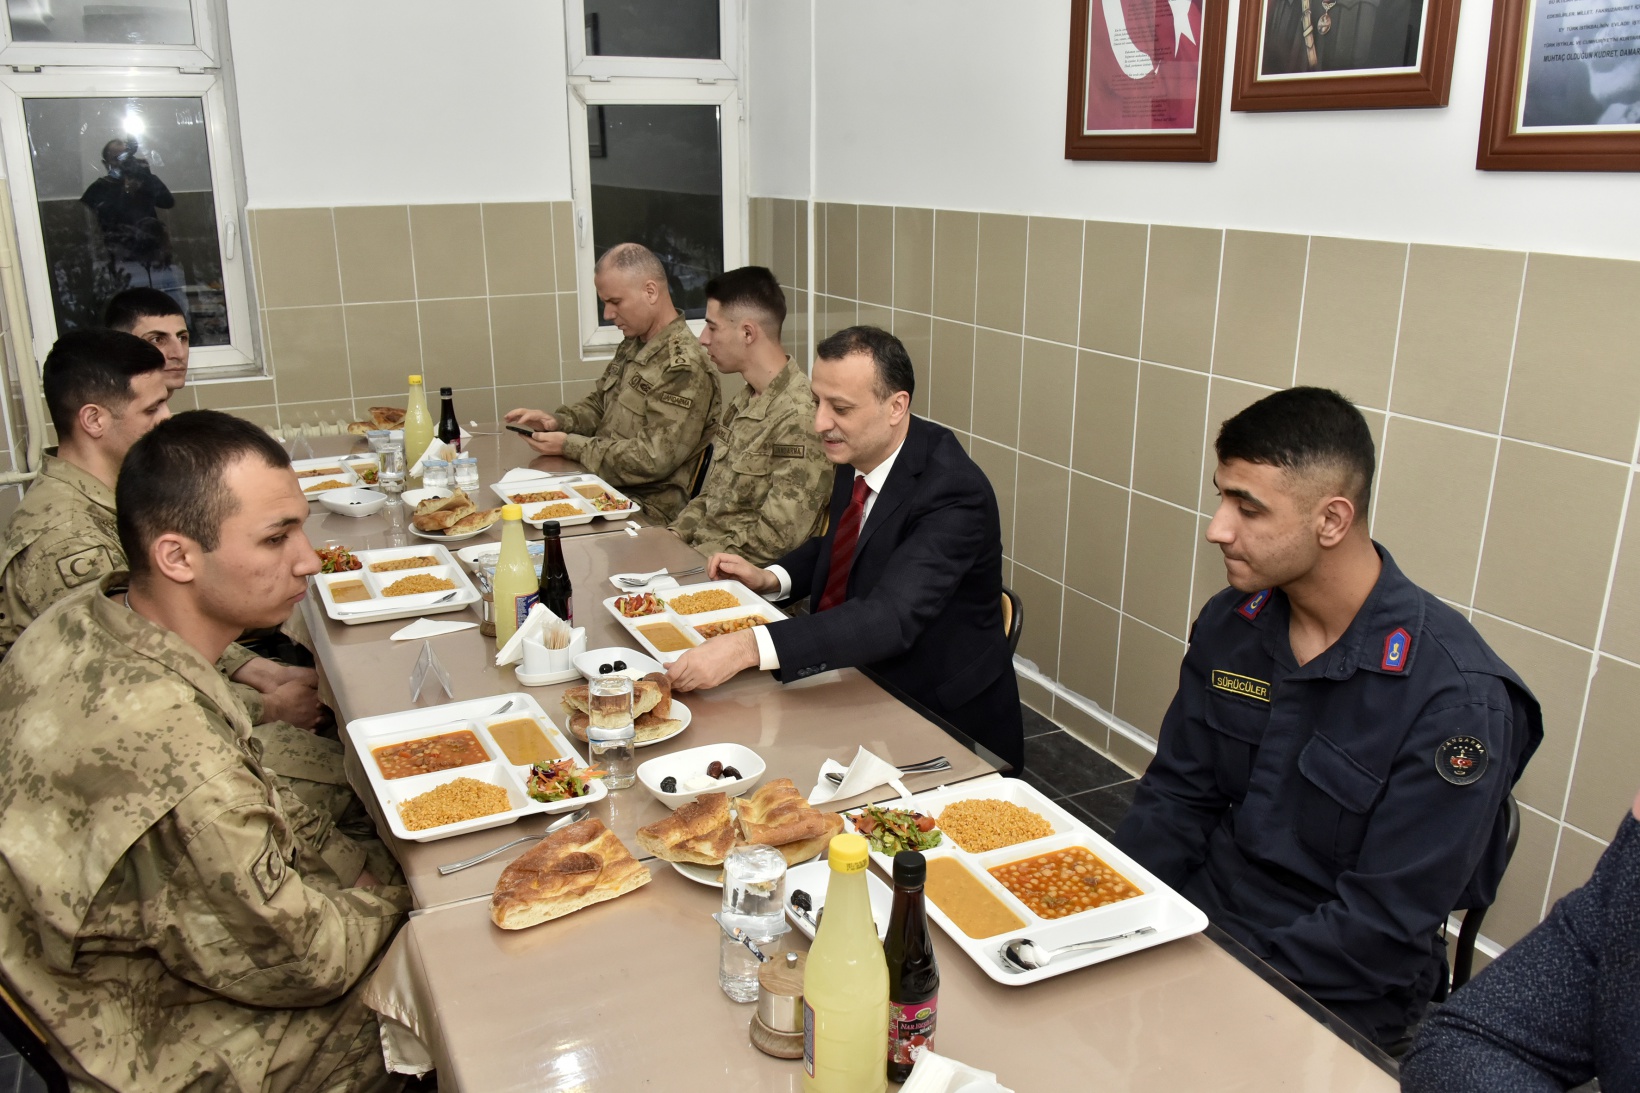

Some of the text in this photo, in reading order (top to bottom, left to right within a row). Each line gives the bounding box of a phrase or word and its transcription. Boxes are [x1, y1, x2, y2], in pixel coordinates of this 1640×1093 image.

[1543, 53, 1566, 62] MUHTAÇ
[1566, 51, 1593, 61] OLDUĞUN
[1216, 676, 1267, 697] SÜRÜCÜLER
